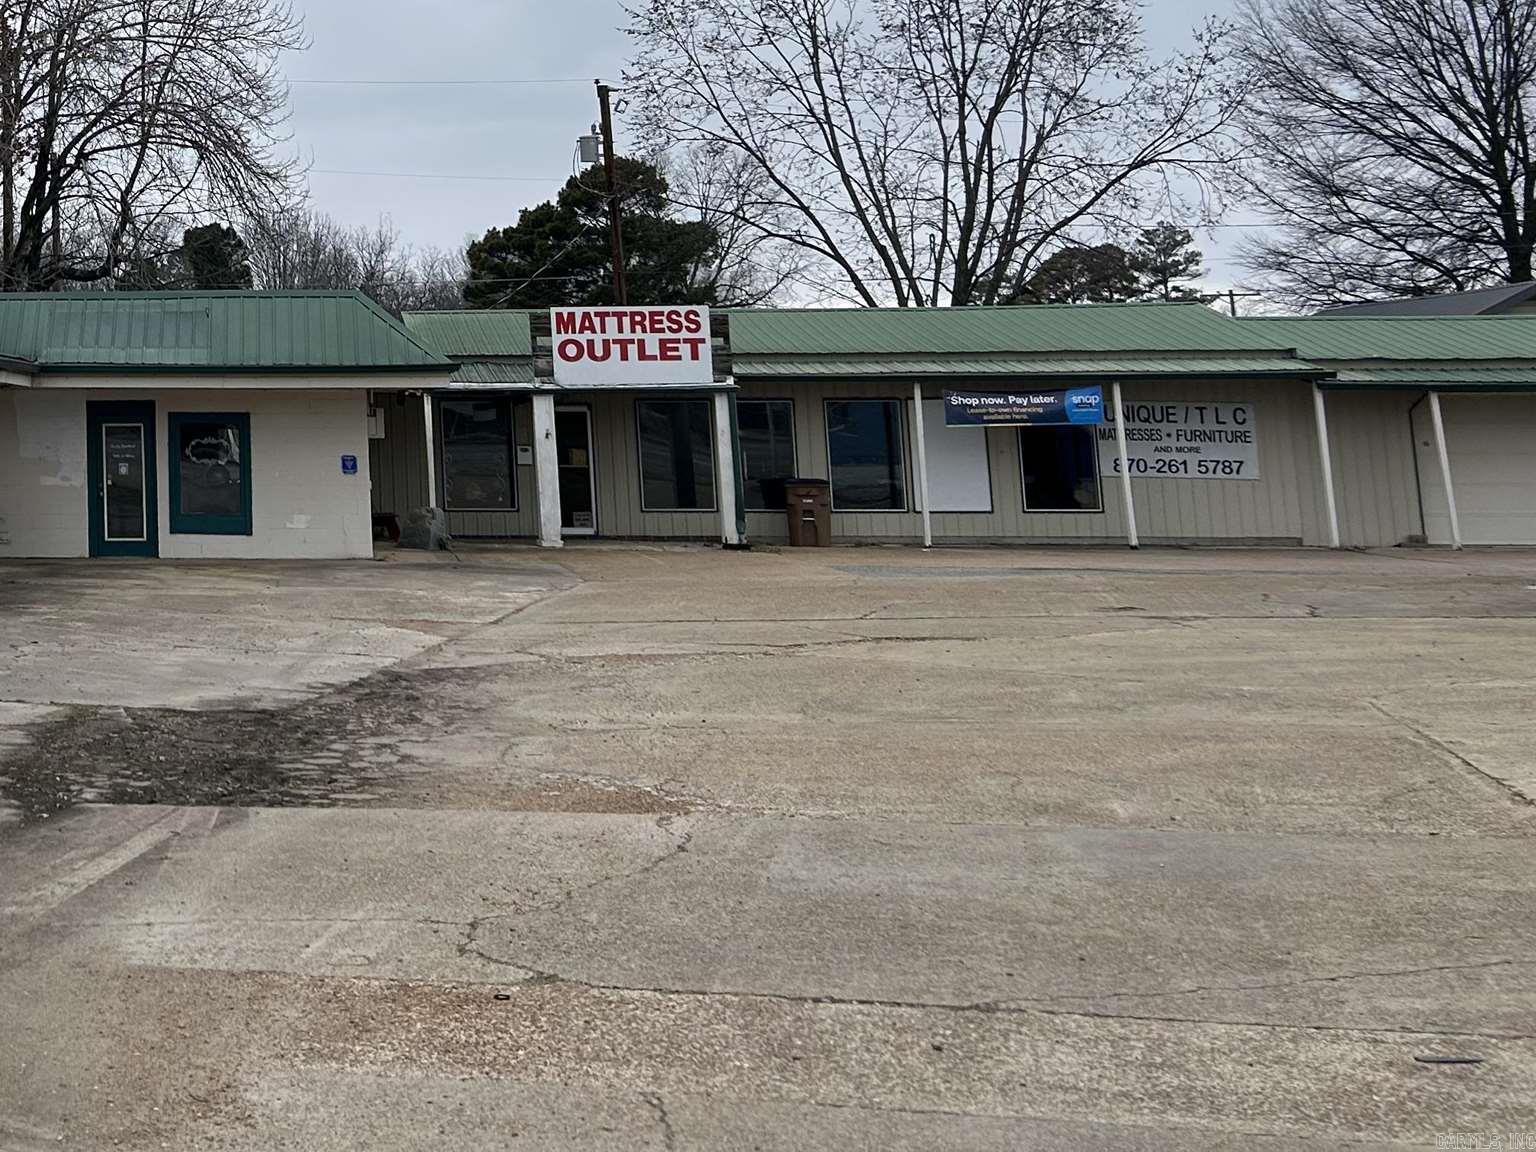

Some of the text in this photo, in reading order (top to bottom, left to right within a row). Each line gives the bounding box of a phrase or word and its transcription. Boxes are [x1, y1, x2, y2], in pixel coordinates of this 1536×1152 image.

[555, 309, 702, 335] MATTRESS
[557, 337, 706, 363] OUTLET
[950, 394, 1058, 407] Shop now. Pay later.
[1072, 395, 1100, 407] snap
[1104, 404, 1178, 424] UNIQUE
[1099, 428, 1253, 444] MATRESSES FURNITURE
[1153, 446, 1203, 454] AND MORE
[1197, 459, 1245, 476] 5787
